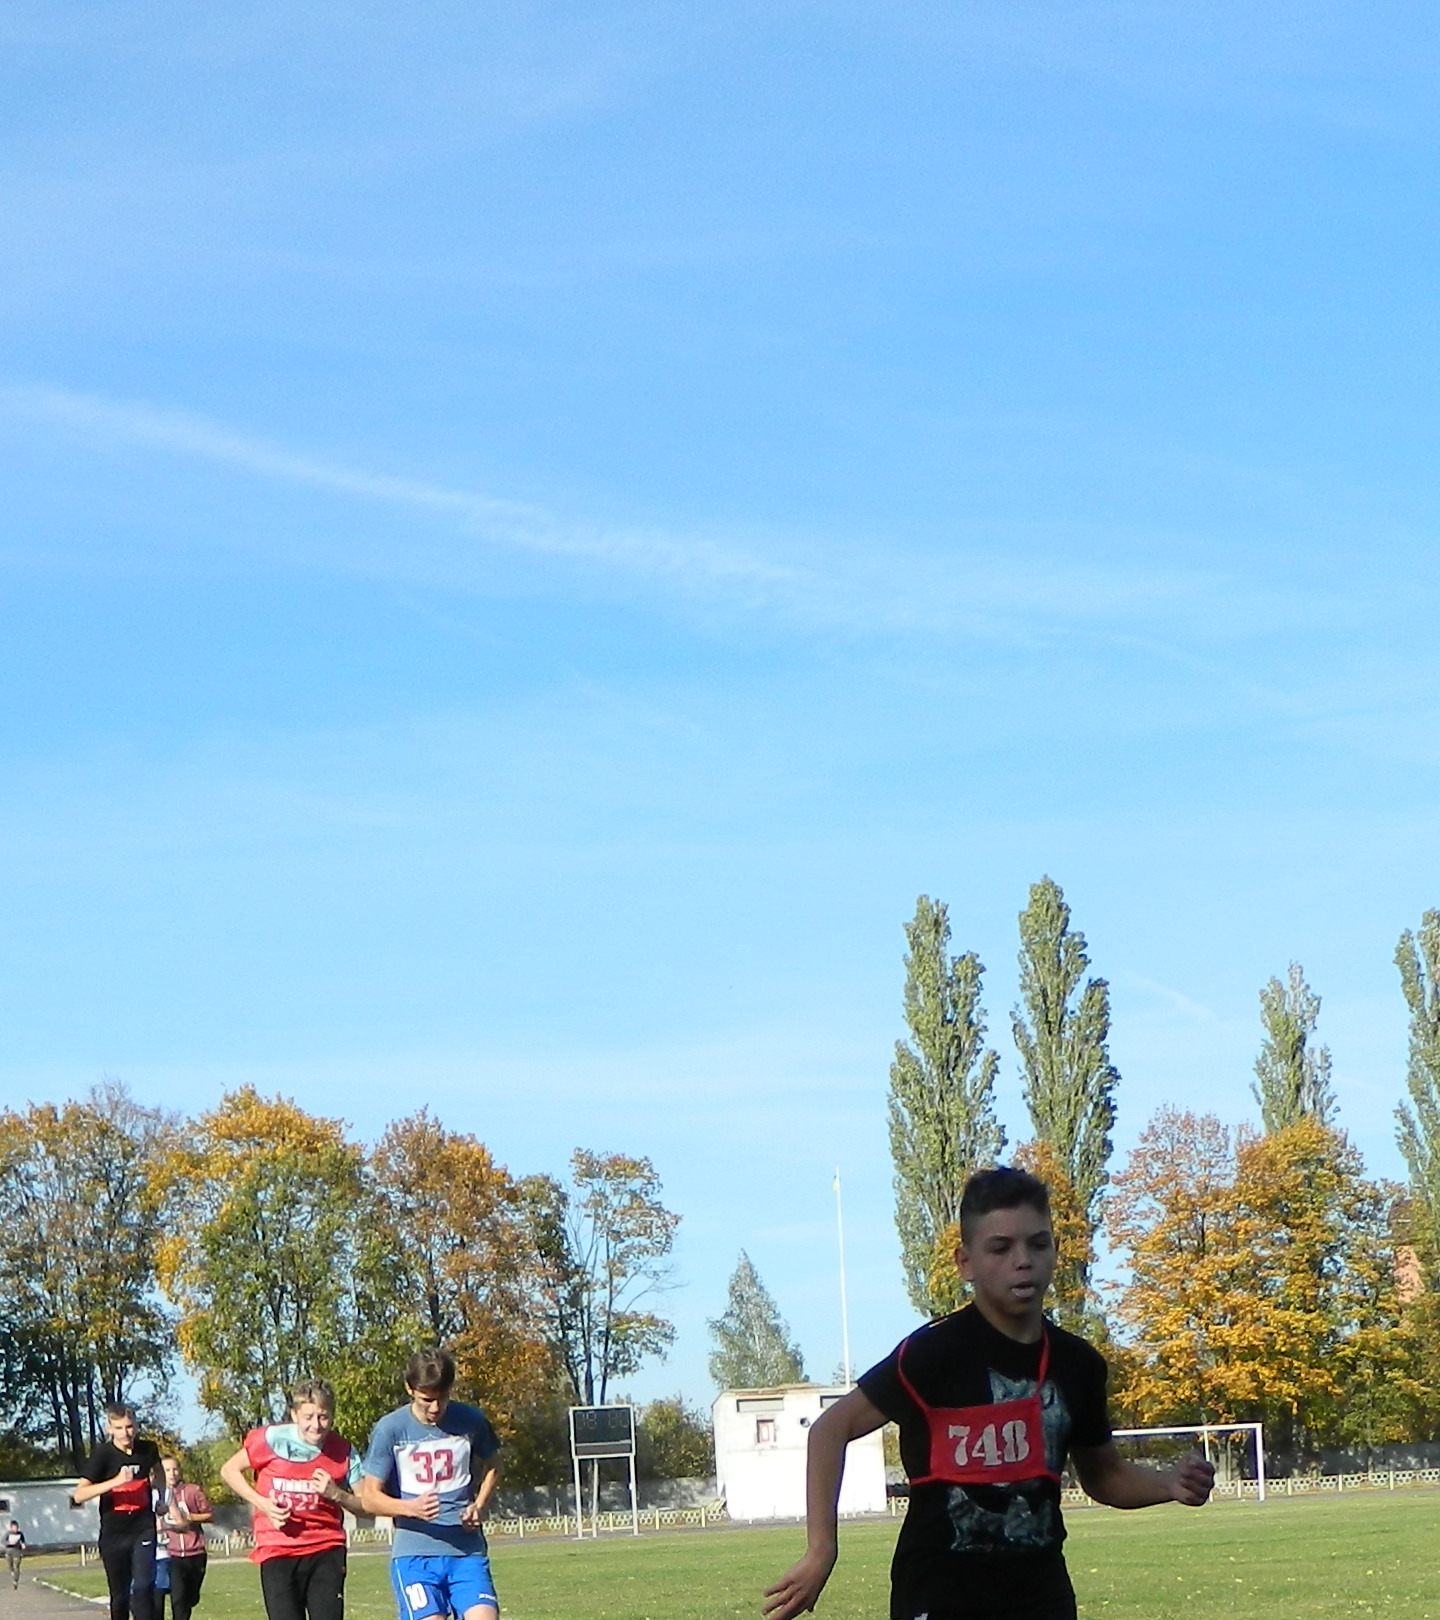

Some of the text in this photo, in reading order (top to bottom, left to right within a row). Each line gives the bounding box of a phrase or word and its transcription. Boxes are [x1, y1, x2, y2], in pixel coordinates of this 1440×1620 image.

[948, 1419, 1030, 1467] 748
[413, 1449, 454, 1484] 33
[405, 1582, 429, 1611] 10
